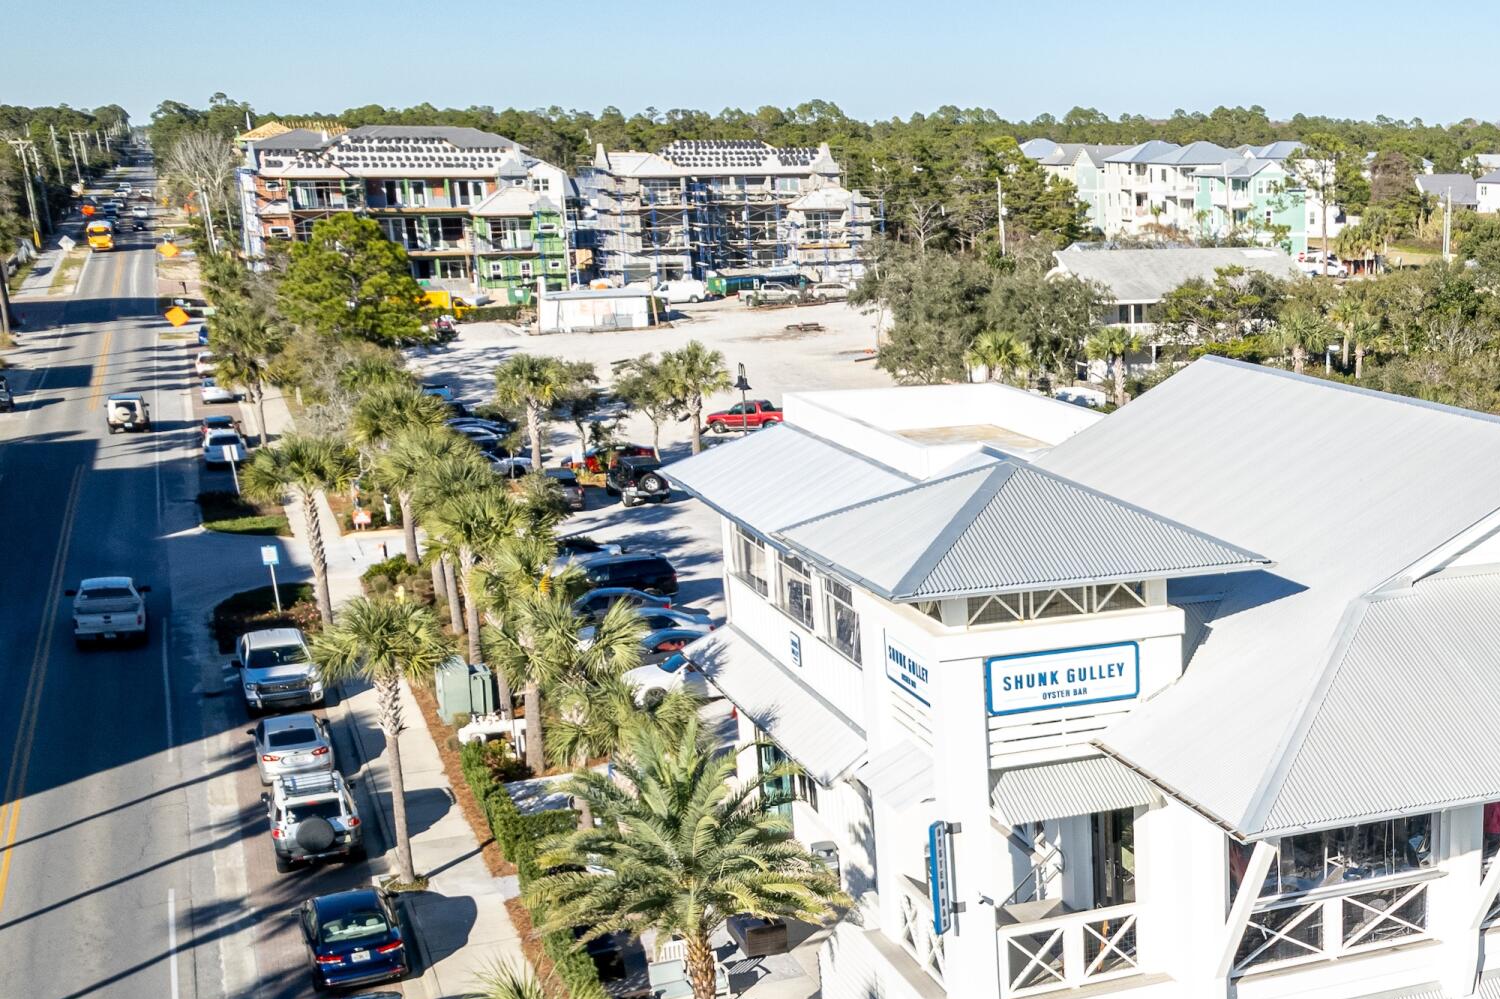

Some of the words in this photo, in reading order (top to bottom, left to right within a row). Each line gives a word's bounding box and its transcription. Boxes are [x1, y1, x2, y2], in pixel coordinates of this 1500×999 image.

[1003, 670, 1059, 691] SHUNK
[1067, 662, 1125, 683] GULLEY
[1042, 689, 1071, 701] OYSTER
[1073, 687, 1088, 697] BAR
